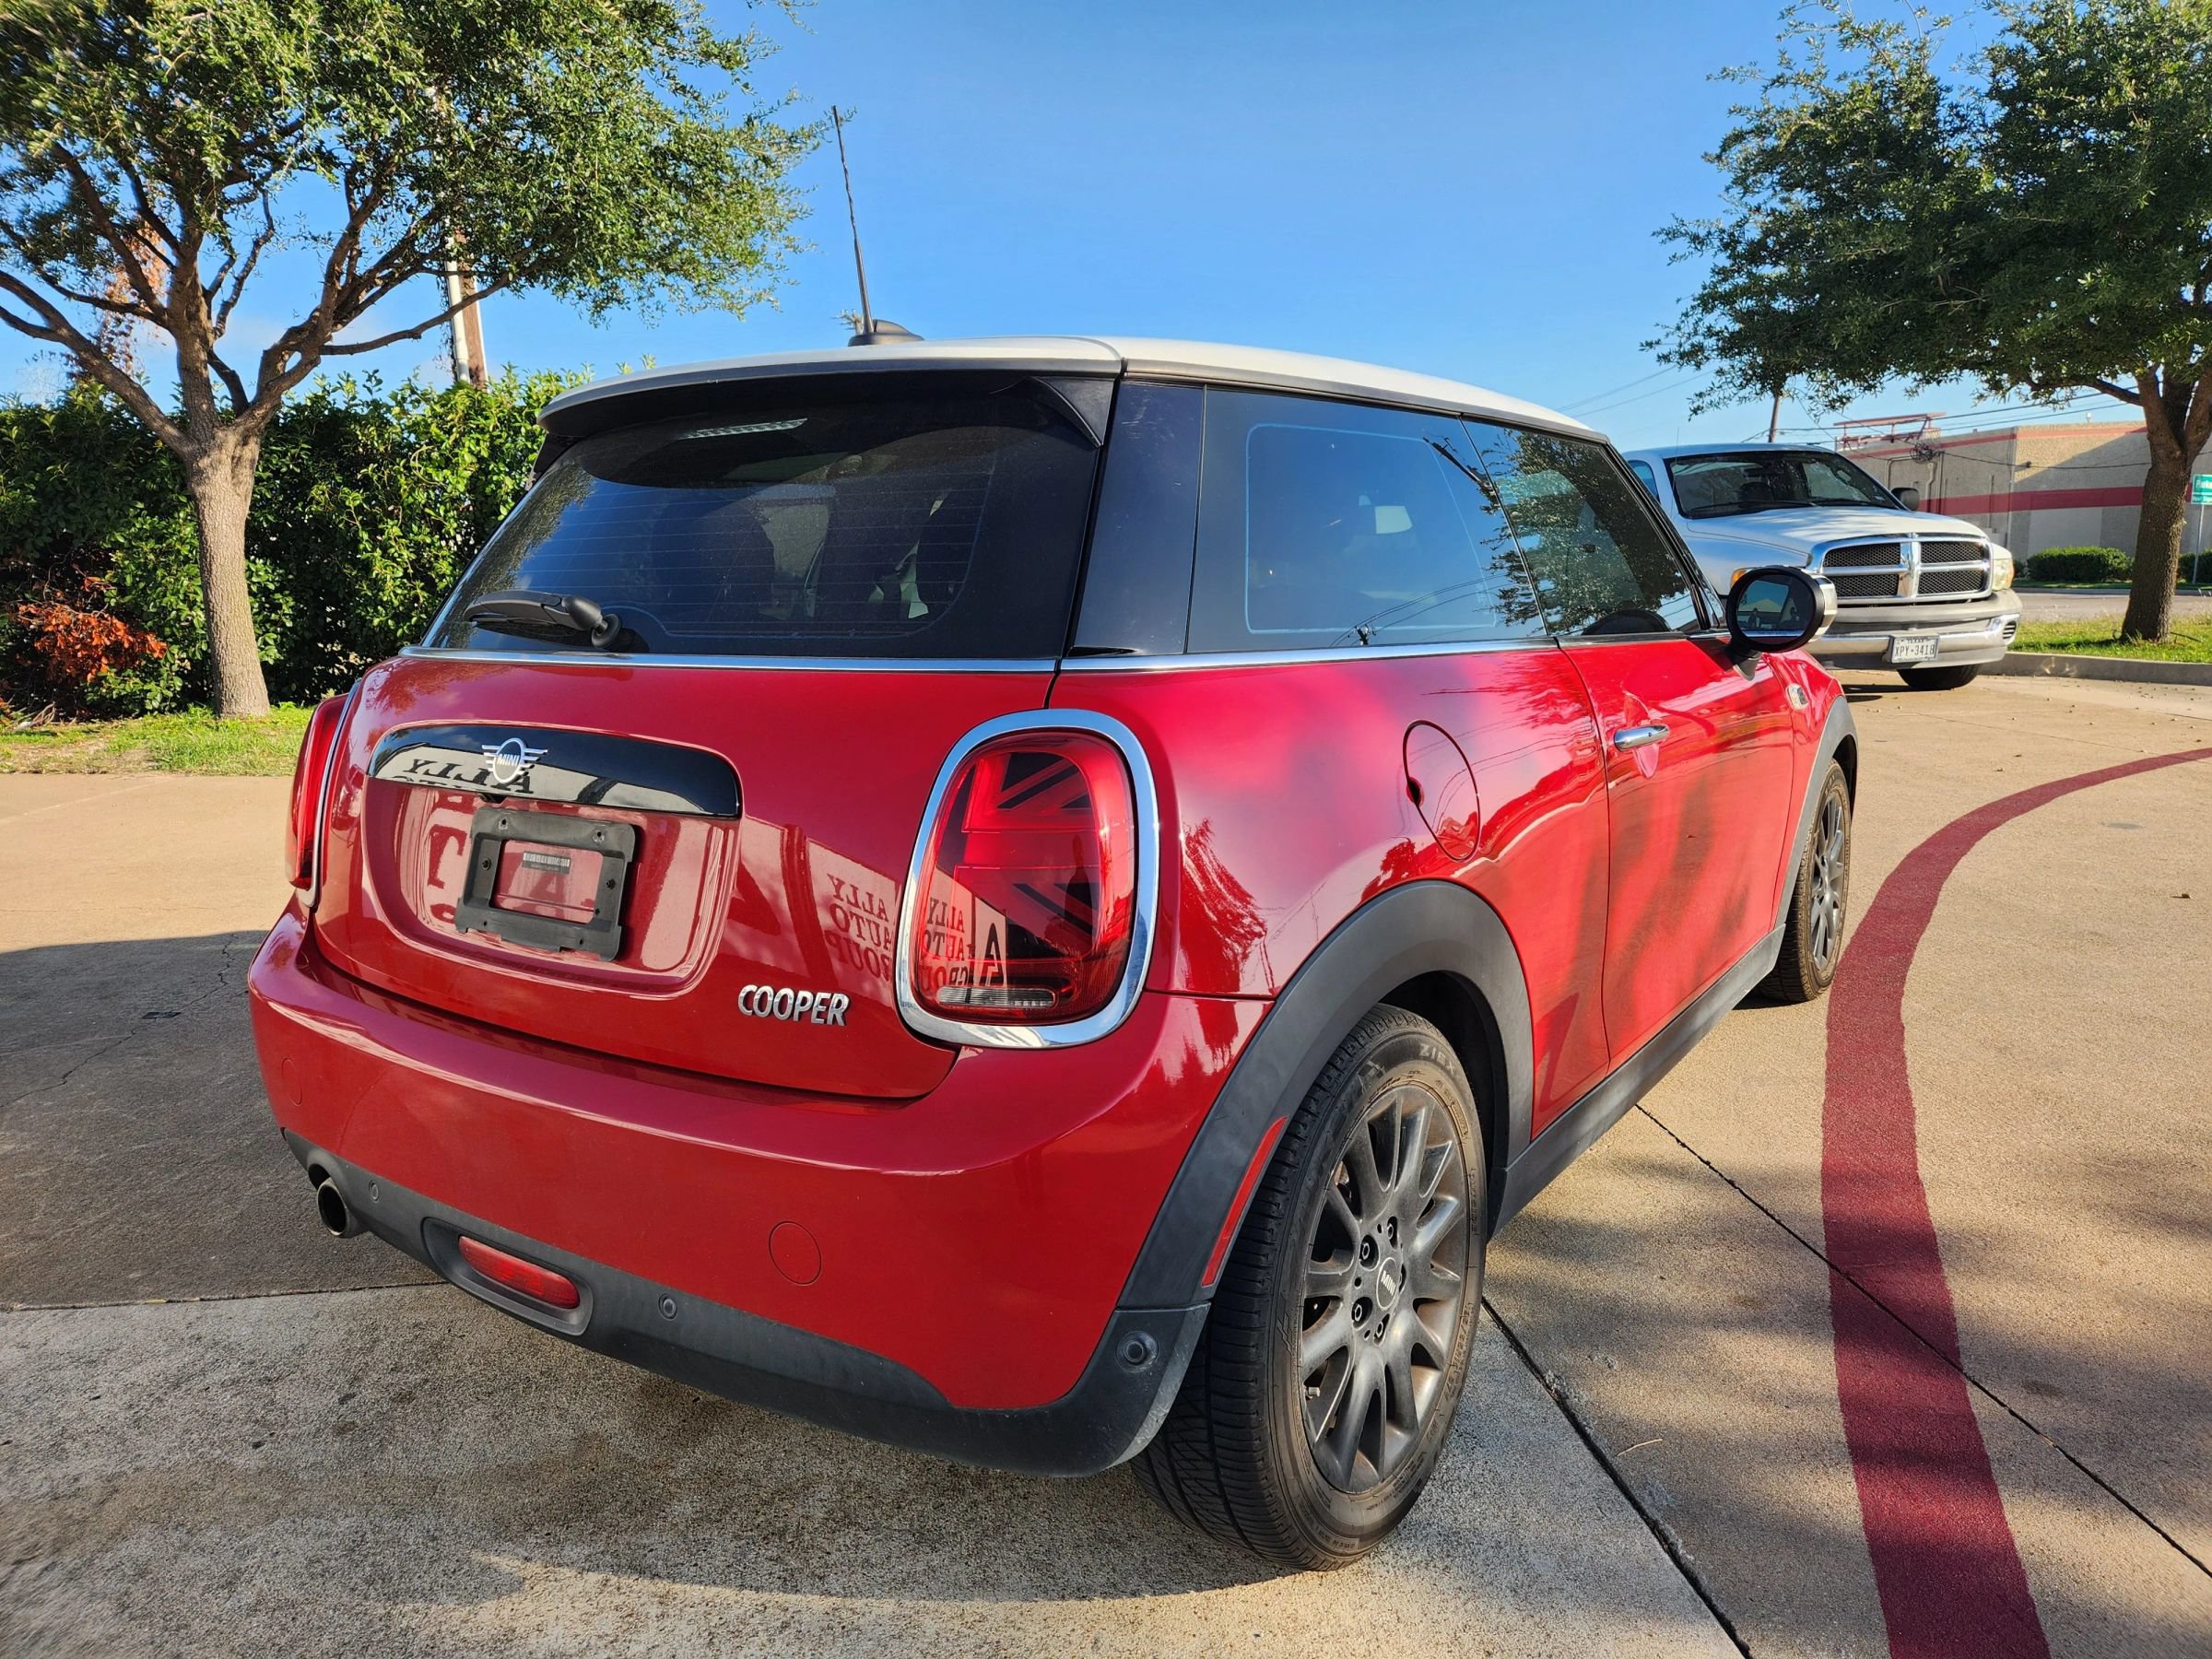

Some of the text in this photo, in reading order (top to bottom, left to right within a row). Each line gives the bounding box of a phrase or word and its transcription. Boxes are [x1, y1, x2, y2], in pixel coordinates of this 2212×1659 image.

[497, 753, 520, 767] MINI
[737, 983, 850, 1027] COOPER
[1380, 1269, 1396, 1297] MINI
